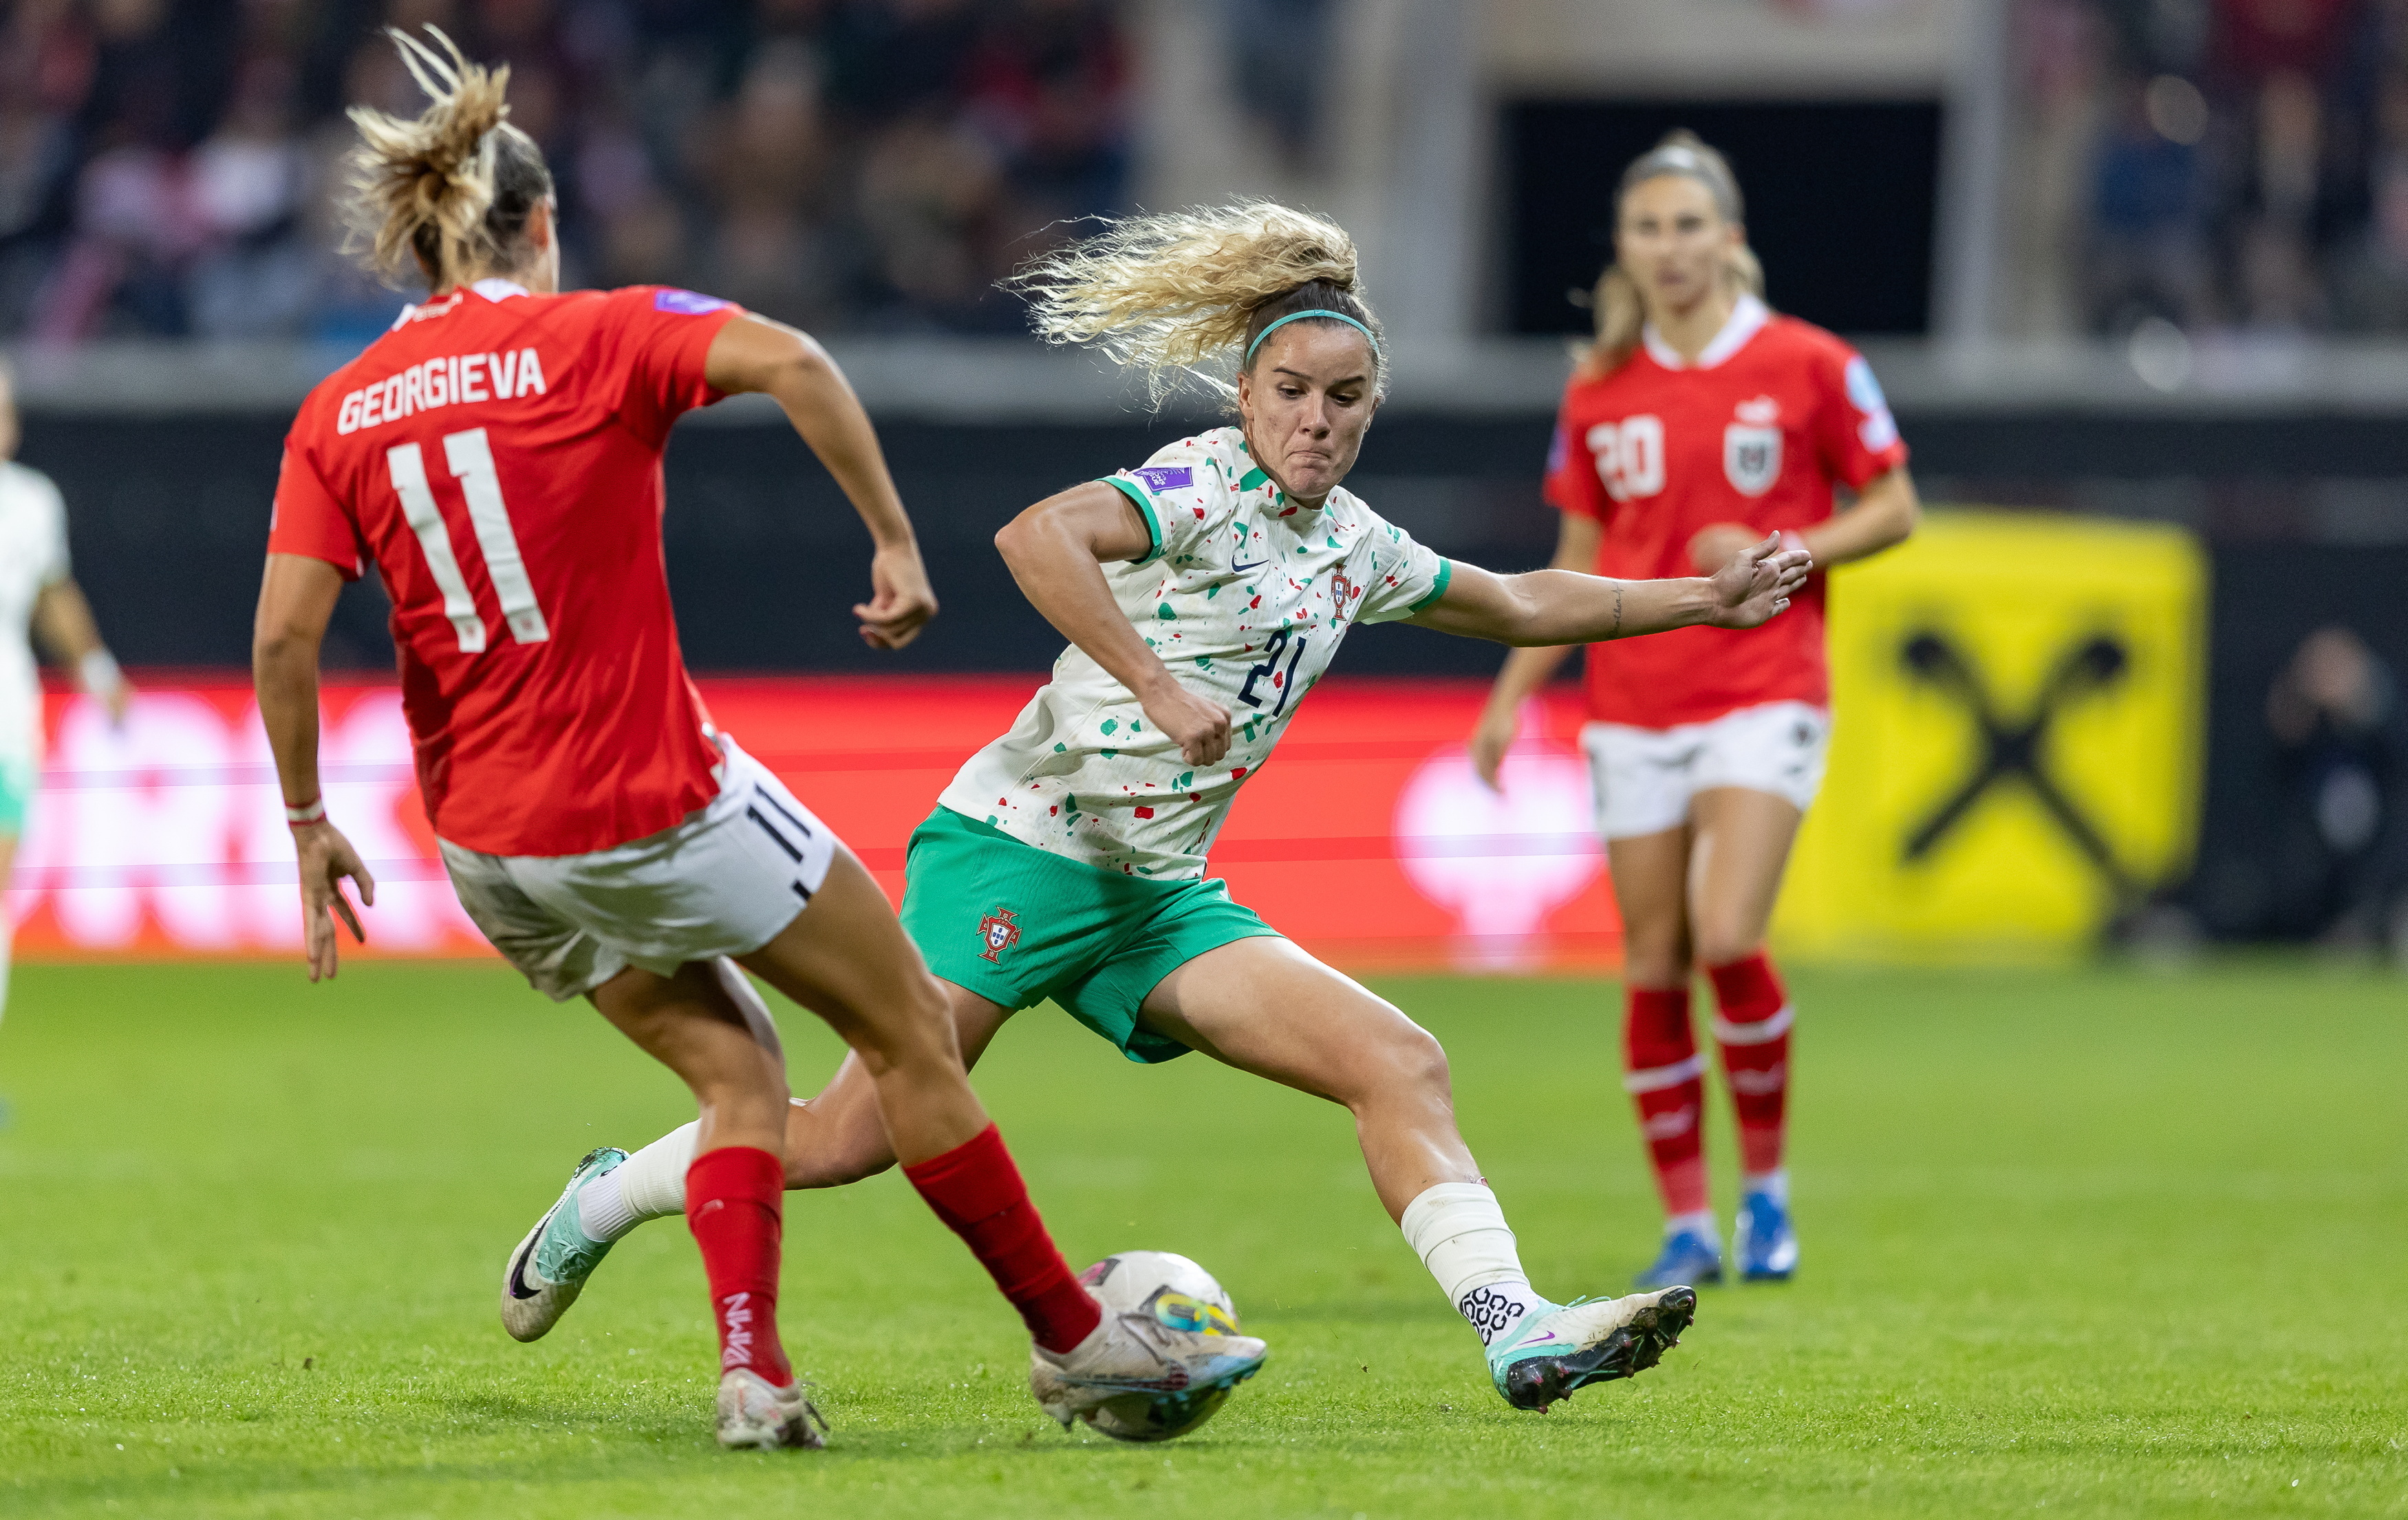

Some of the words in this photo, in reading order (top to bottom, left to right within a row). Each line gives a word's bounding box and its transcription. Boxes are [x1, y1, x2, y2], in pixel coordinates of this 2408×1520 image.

[336, 347, 547, 436] GEORGIEVA
[1584, 413, 1666, 502] 20
[386, 426, 550, 653] 11
[1237, 629, 1307, 718] 21
[746, 782, 812, 864] 11
